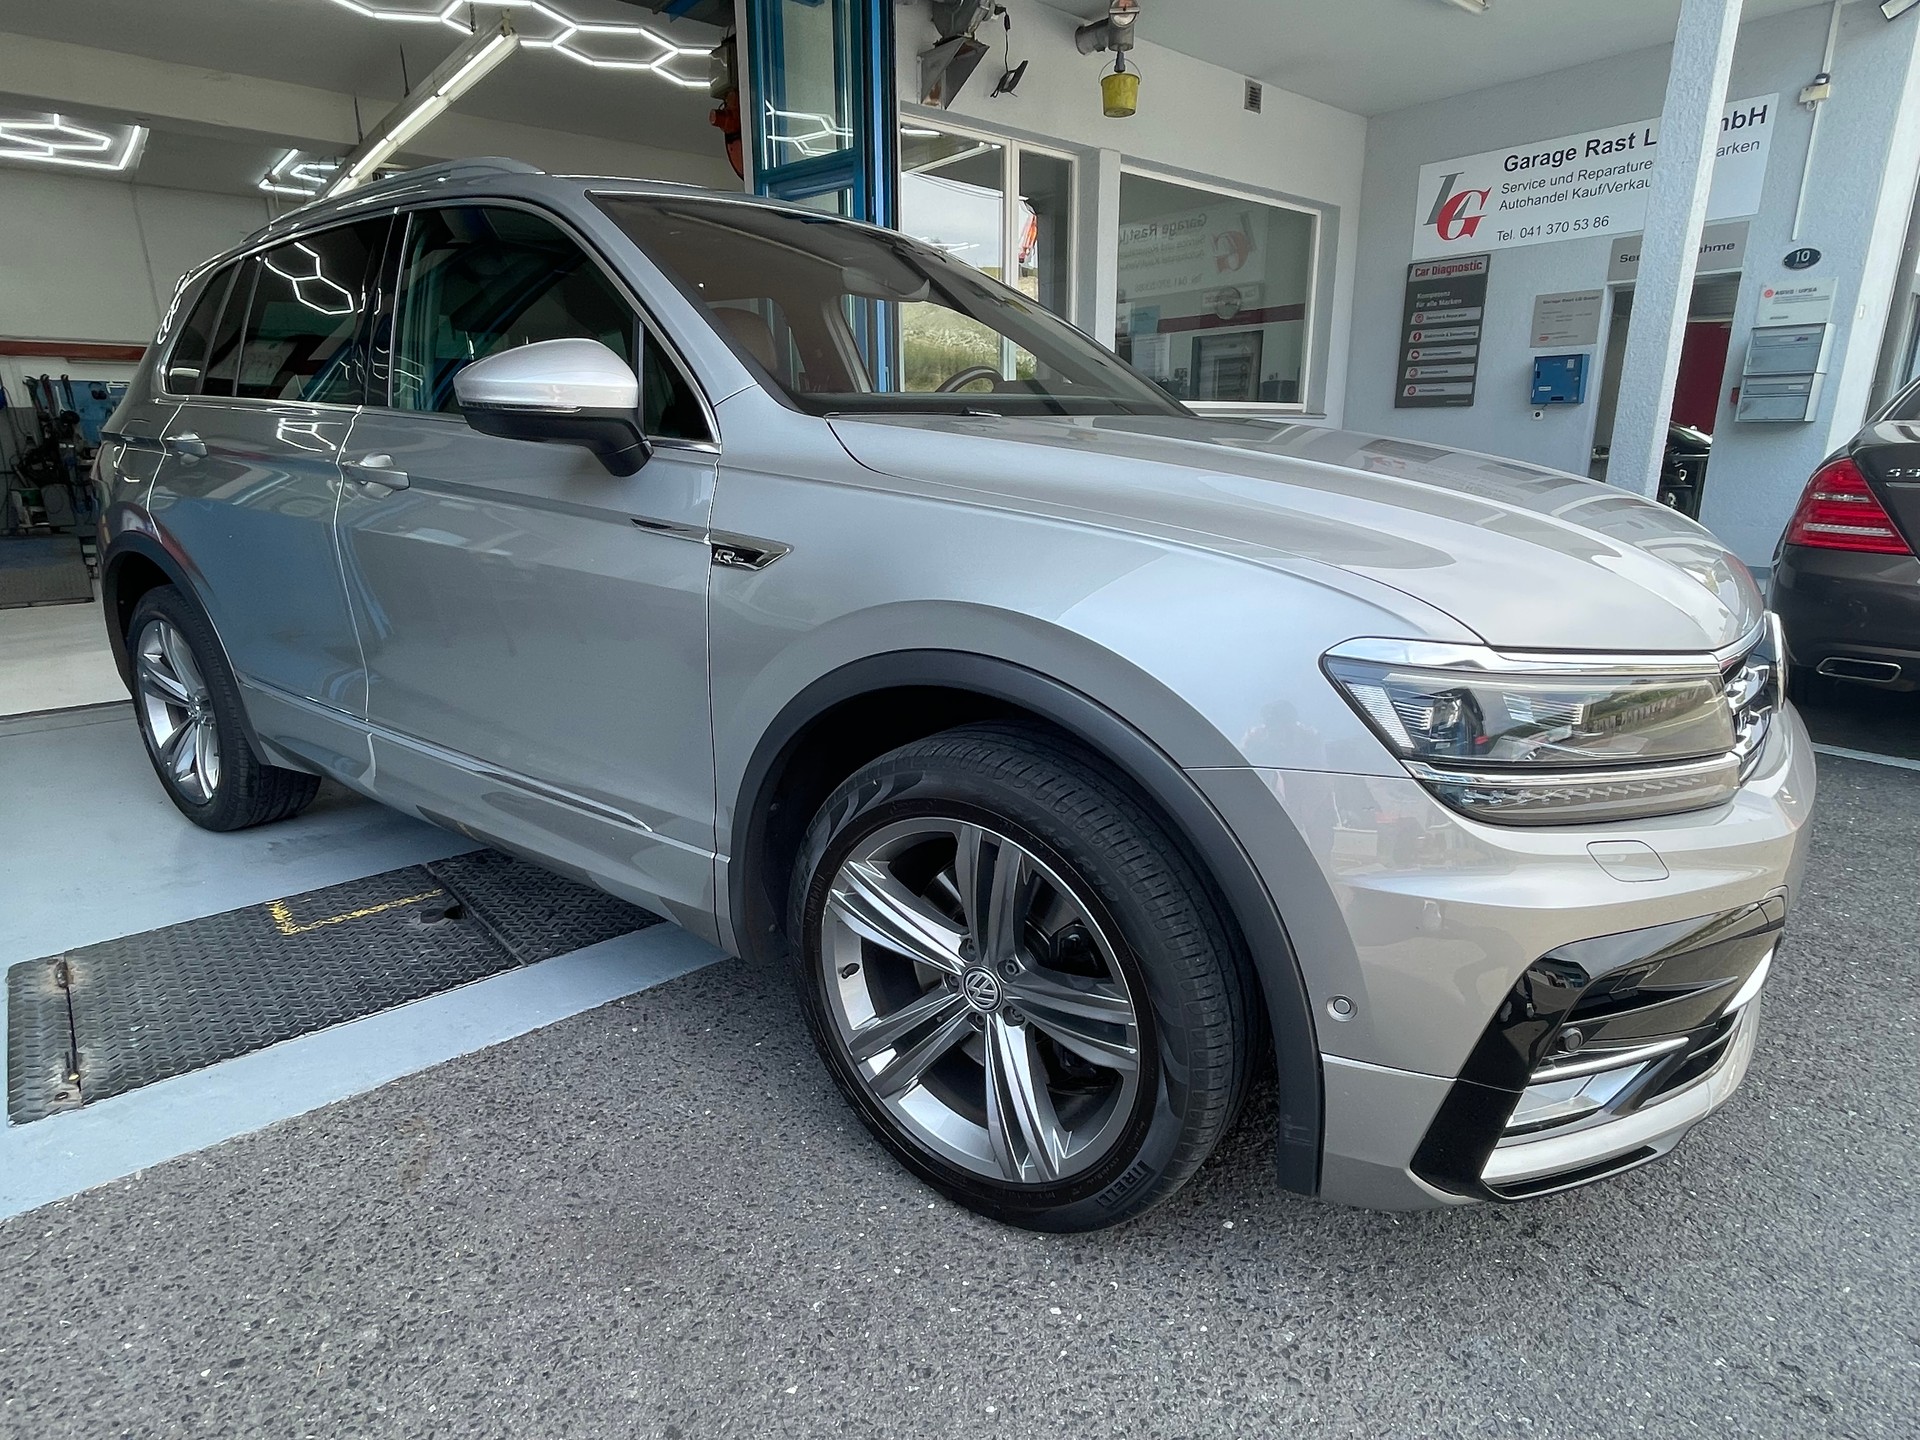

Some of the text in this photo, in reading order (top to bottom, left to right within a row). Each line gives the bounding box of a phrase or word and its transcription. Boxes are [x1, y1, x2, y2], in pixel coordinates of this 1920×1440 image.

[1504, 104, 1768, 172] Garage Rast L bH
[1501, 140, 1760, 195] Service und Reparature arken
[1499, 177, 1651, 211] Autohandel Kauf/Verkau
[1497, 215, 1610, 242] Tel. 041 370 53 86
[1699, 242, 1736, 254] hme
[1795, 250, 1811, 262] 10
[1415, 260, 1483, 277] Car Diagnostic
